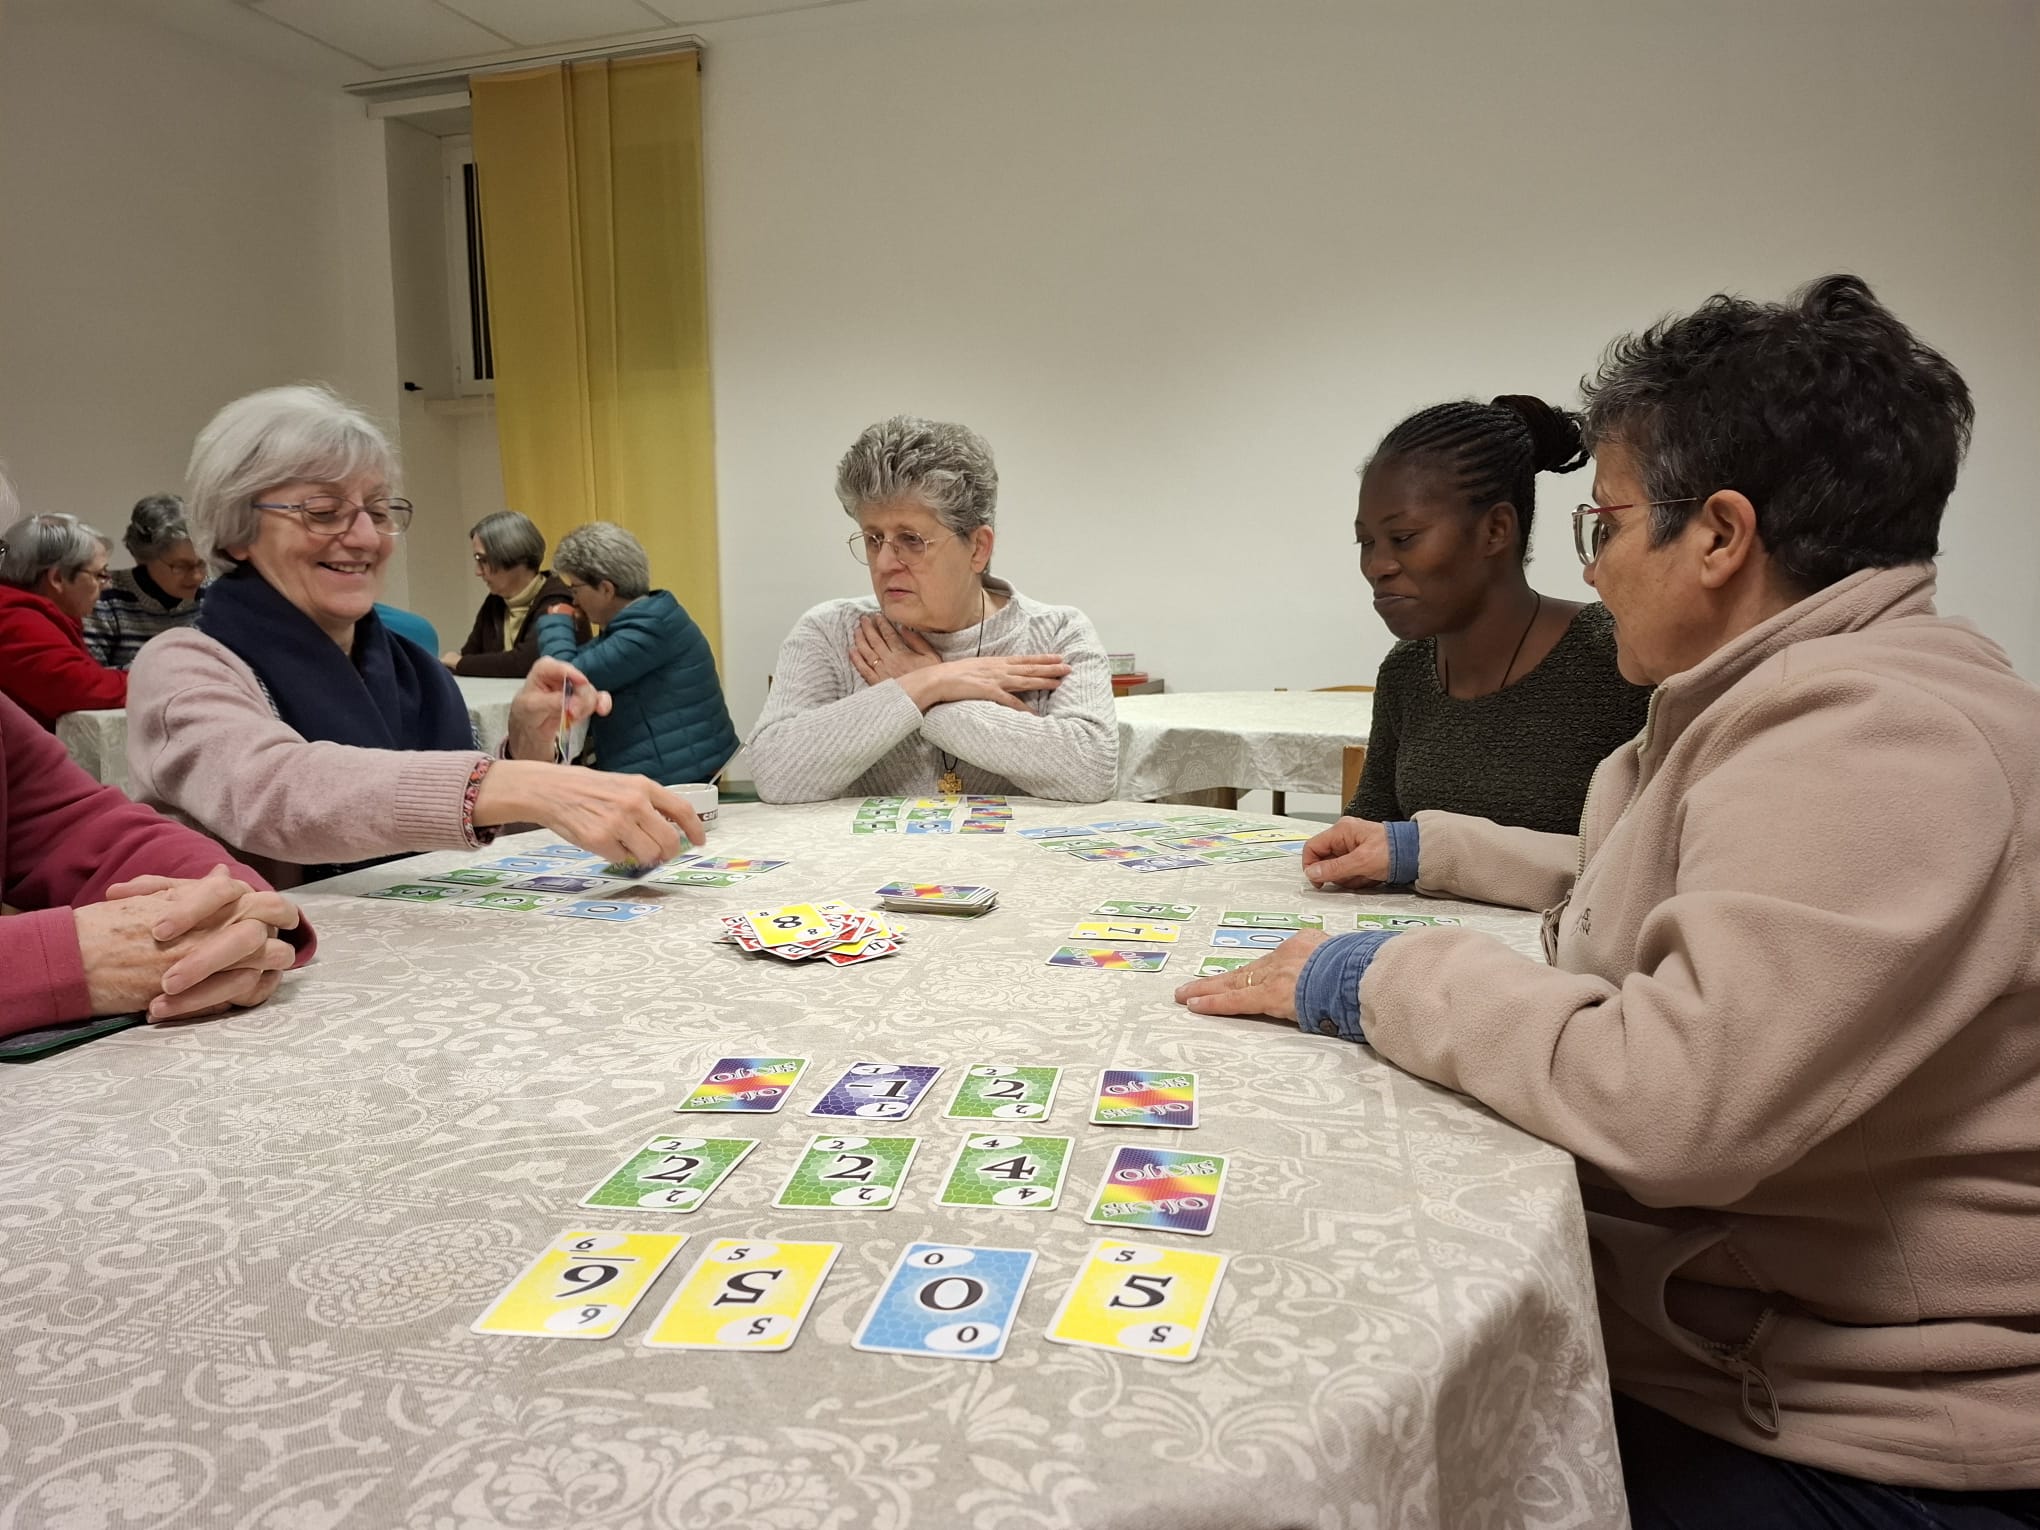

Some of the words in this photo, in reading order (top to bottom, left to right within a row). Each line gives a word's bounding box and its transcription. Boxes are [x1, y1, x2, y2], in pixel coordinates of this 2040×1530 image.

[772, 916, 802, 928] 8
[807, 928, 818, 936] 8
[1249, 934, 1284, 943] 0
[860, 1065, 881, 1074] -1
[986, 1068, 998, 1076] 2
[849, 1079, 908, 1100] -1
[982, 1079, 1025, 1101] 2
[876, 1104, 898, 1112] -1
[1015, 1104, 1030, 1115] 2
[667, 1141, 682, 1150] 2
[832, 1140, 845, 1150] 2
[982, 1139, 999, 1148] 4
[641, 1155, 700, 1183] 2
[823, 1155, 876, 1182] 2
[979, 1155, 1037, 1180] 4
[665, 1190, 686, 1202] 2
[858, 1188, 877, 1200] 2
[1017, 1188, 1037, 1200] 4
[572, 1238, 597, 1251] 6
[728, 1248, 750, 1260] 5
[924, 1252, 944, 1265] 0
[1115, 1250, 1136, 1262] 5
[554, 1260, 625, 1298] 6
[713, 1269, 783, 1306] 5
[1109, 1275, 1174, 1309] 5
[920, 1277, 983, 1311] 0
[578, 1305, 604, 1324] 6
[747, 1318, 773, 1335] 5
[957, 1326, 979, 1342] 0
[1150, 1325, 1171, 1343] 5
